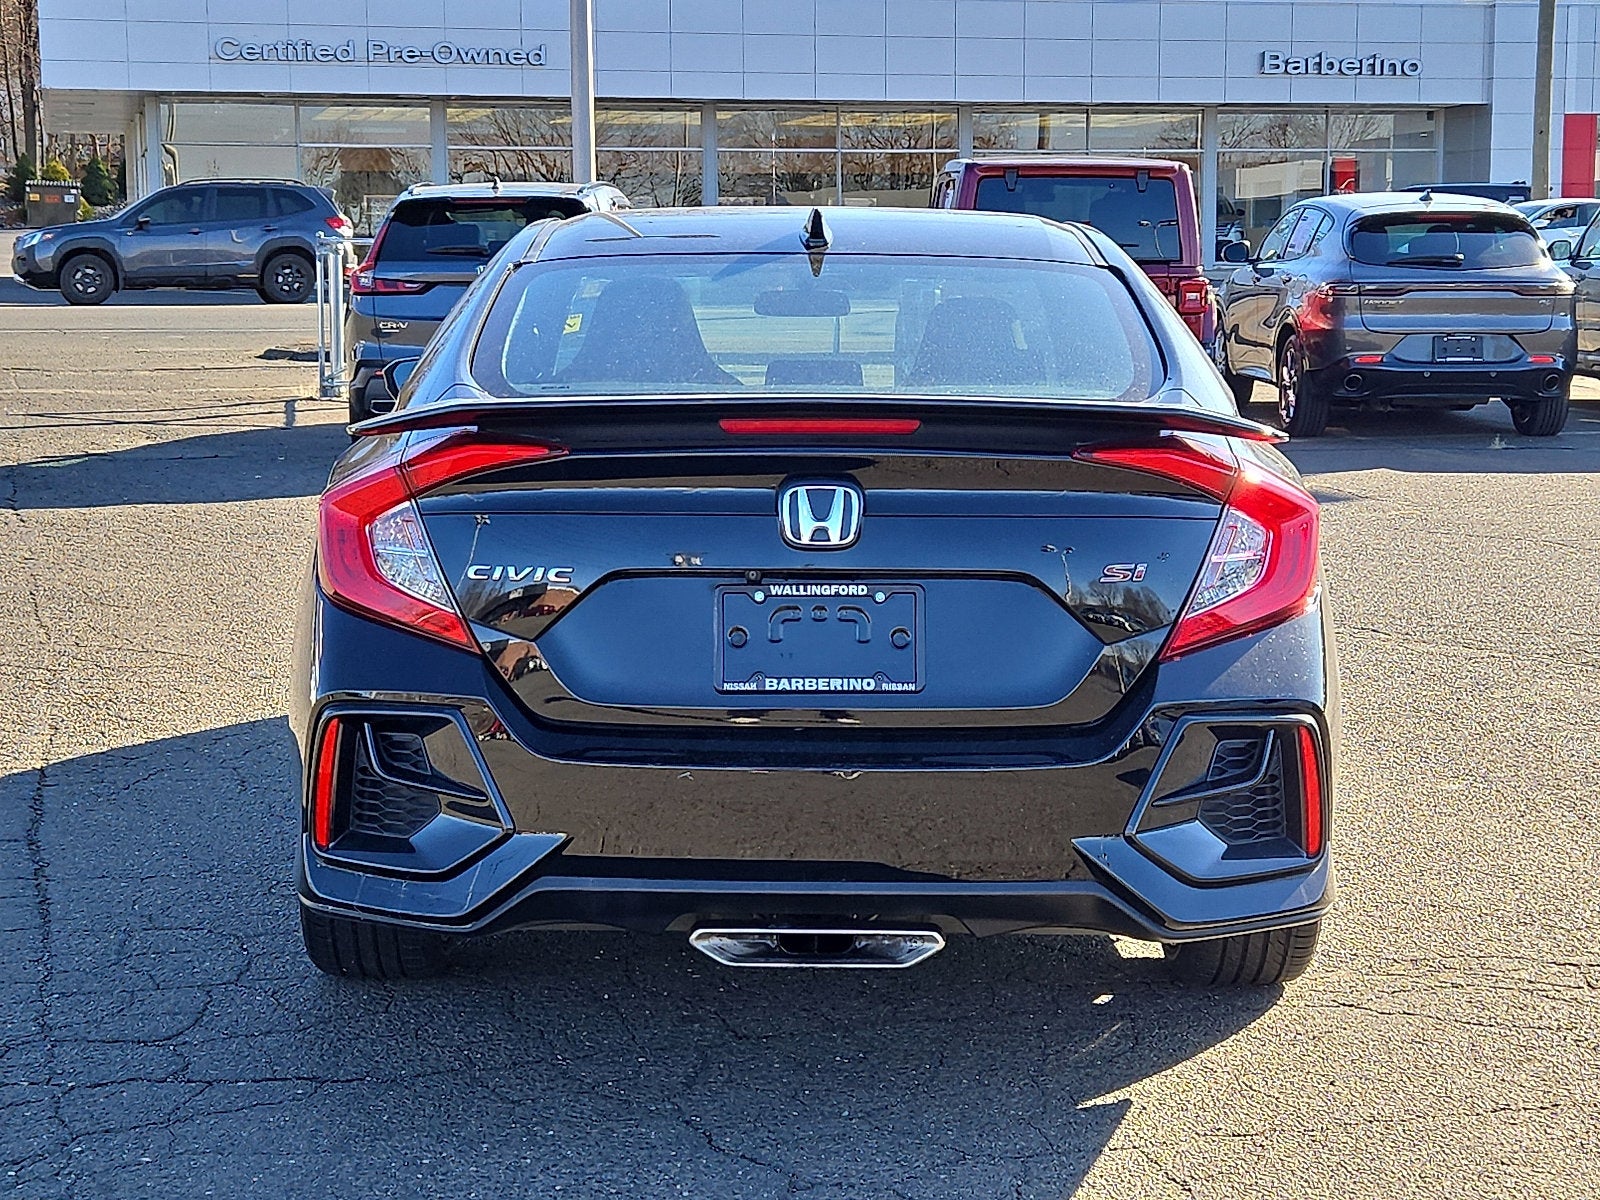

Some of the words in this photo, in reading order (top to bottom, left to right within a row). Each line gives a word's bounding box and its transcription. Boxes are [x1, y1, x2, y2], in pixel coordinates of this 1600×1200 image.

[214, 37, 356, 62] Certified
[366, 40, 547, 66] Pre-Owned
[1260, 51, 1423, 75] Barberino
[467, 565, 574, 583] CIVIC
[769, 584, 868, 596] WALLINGFORD
[723, 682, 757, 691] NISSAN
[764, 677, 876, 691] BARBERINO
[881, 683, 916, 691] NISSAN
